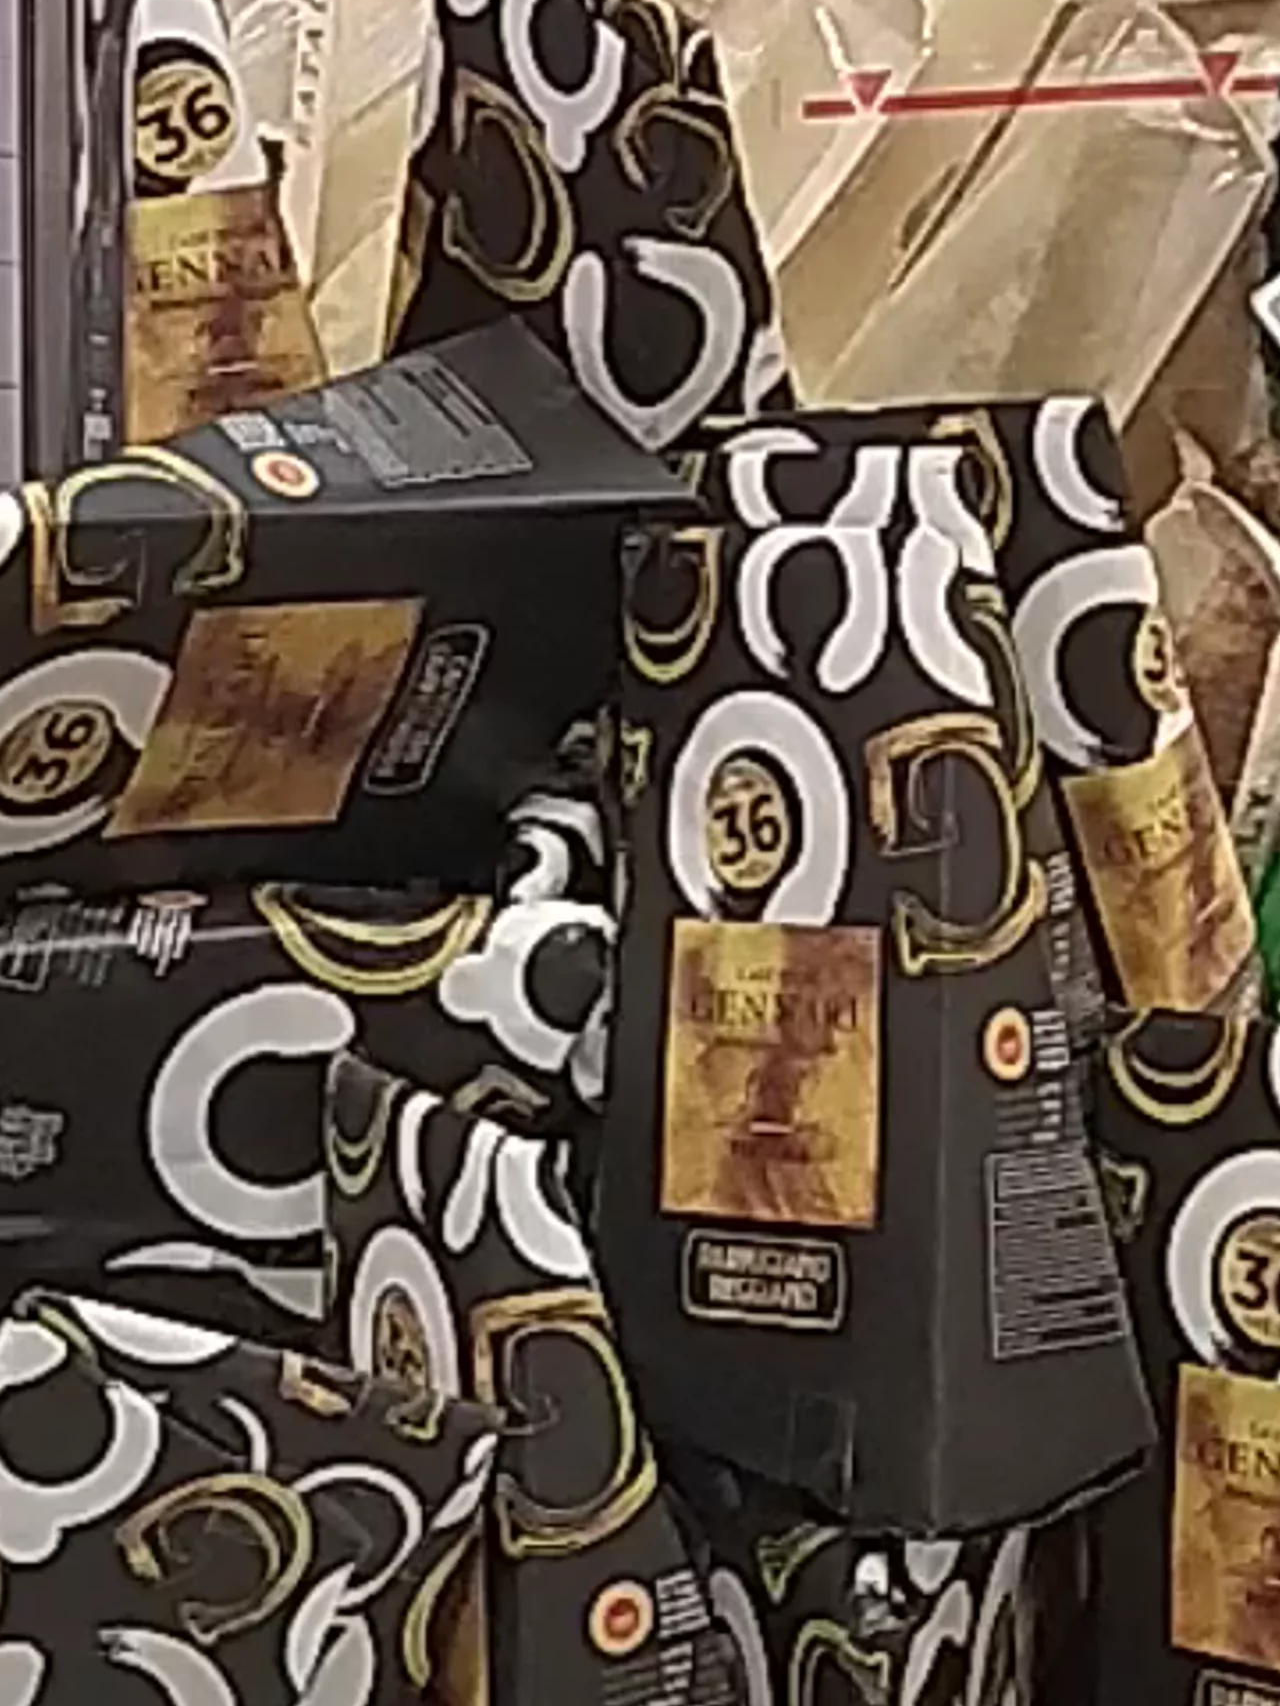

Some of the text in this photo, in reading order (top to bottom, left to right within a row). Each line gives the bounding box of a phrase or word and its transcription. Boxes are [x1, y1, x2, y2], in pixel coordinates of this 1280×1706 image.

[135, 79, 234, 167] 36
[11, 711, 98, 795] 36
[712, 793, 782, 866] 36
